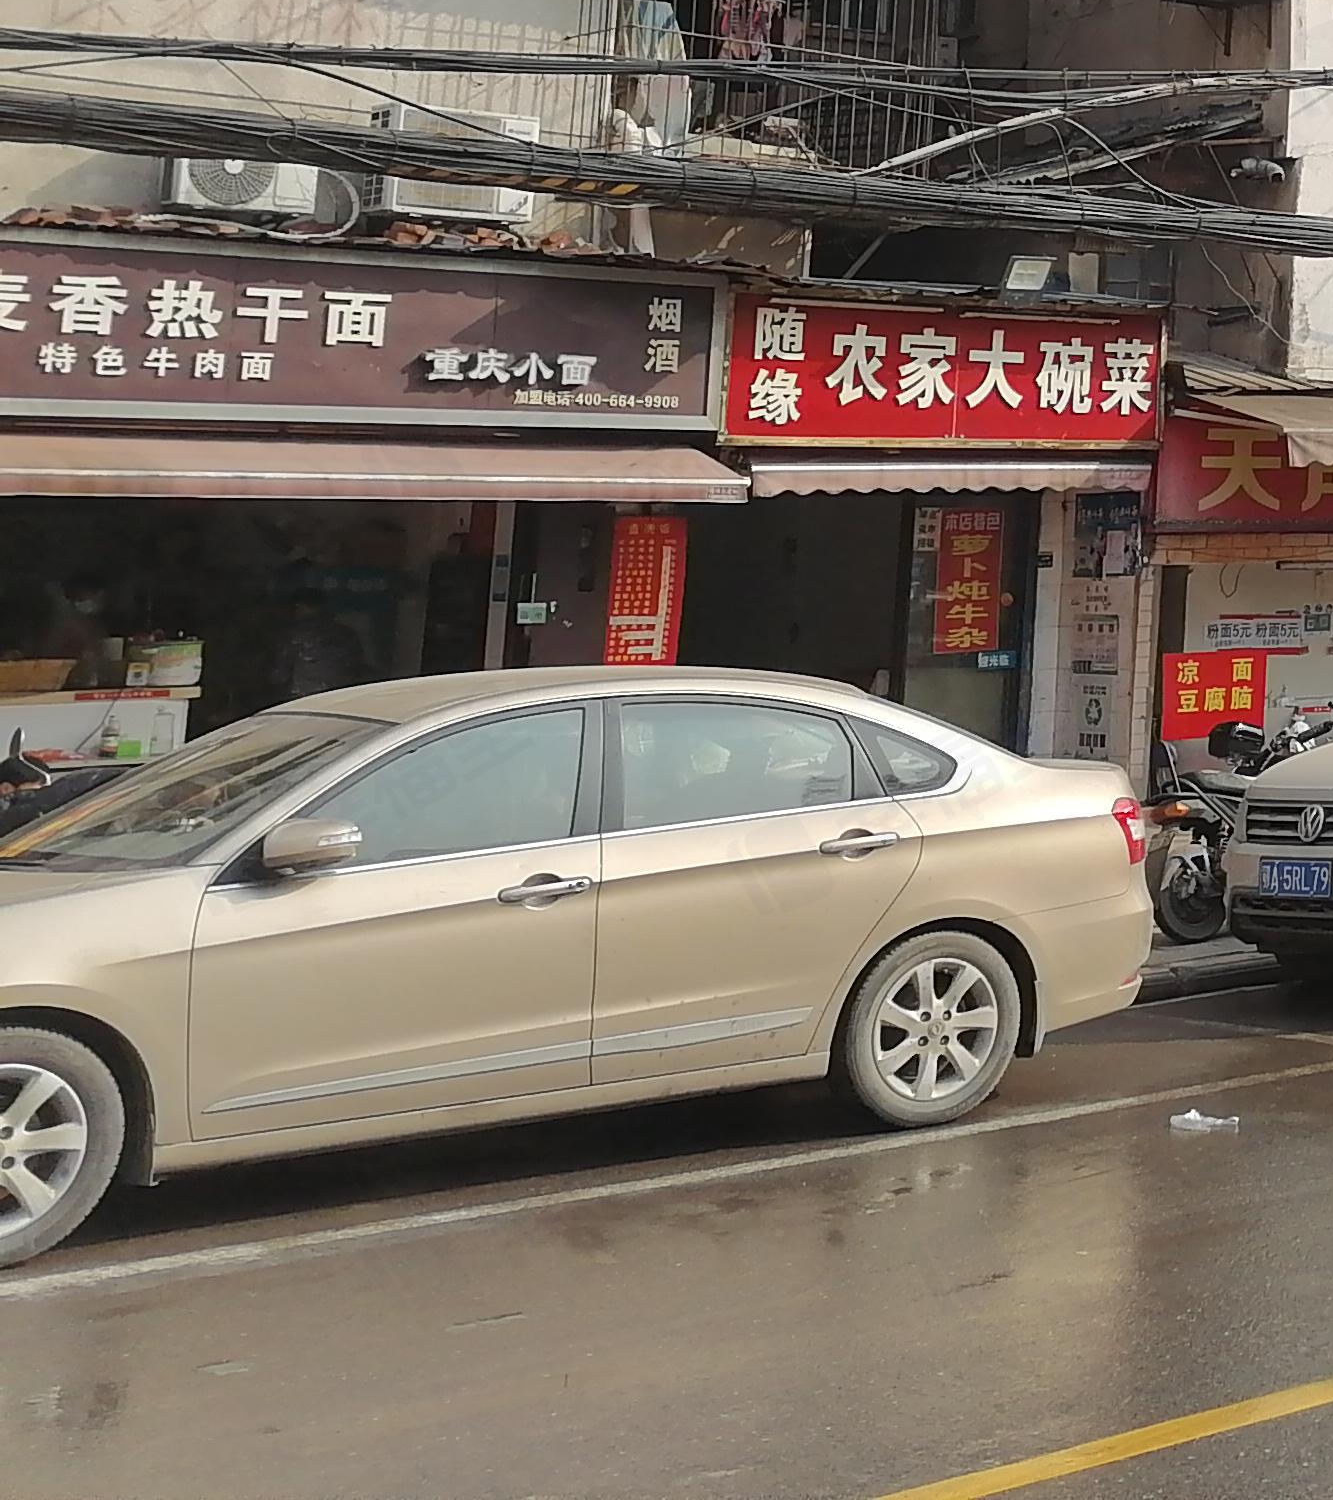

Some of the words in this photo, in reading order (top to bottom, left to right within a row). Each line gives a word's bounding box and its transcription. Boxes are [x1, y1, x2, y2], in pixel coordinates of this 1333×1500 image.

[38, 342, 275, 381] 特色牛肉面
[644, 297, 682, 373] 烟酒
[425, 347, 597, 385] 重庆小面
[749, 306, 805, 426] 随缘
[825, 324, 1155, 417] 农家大碗菜
[945, 534, 993, 648] 萝卜炖牛杂
[1206, 623, 1252, 640] 粉面5元
[1255, 622, 1300, 639] 粉面5元
[1176, 686, 1254, 714] 豆腐脑
